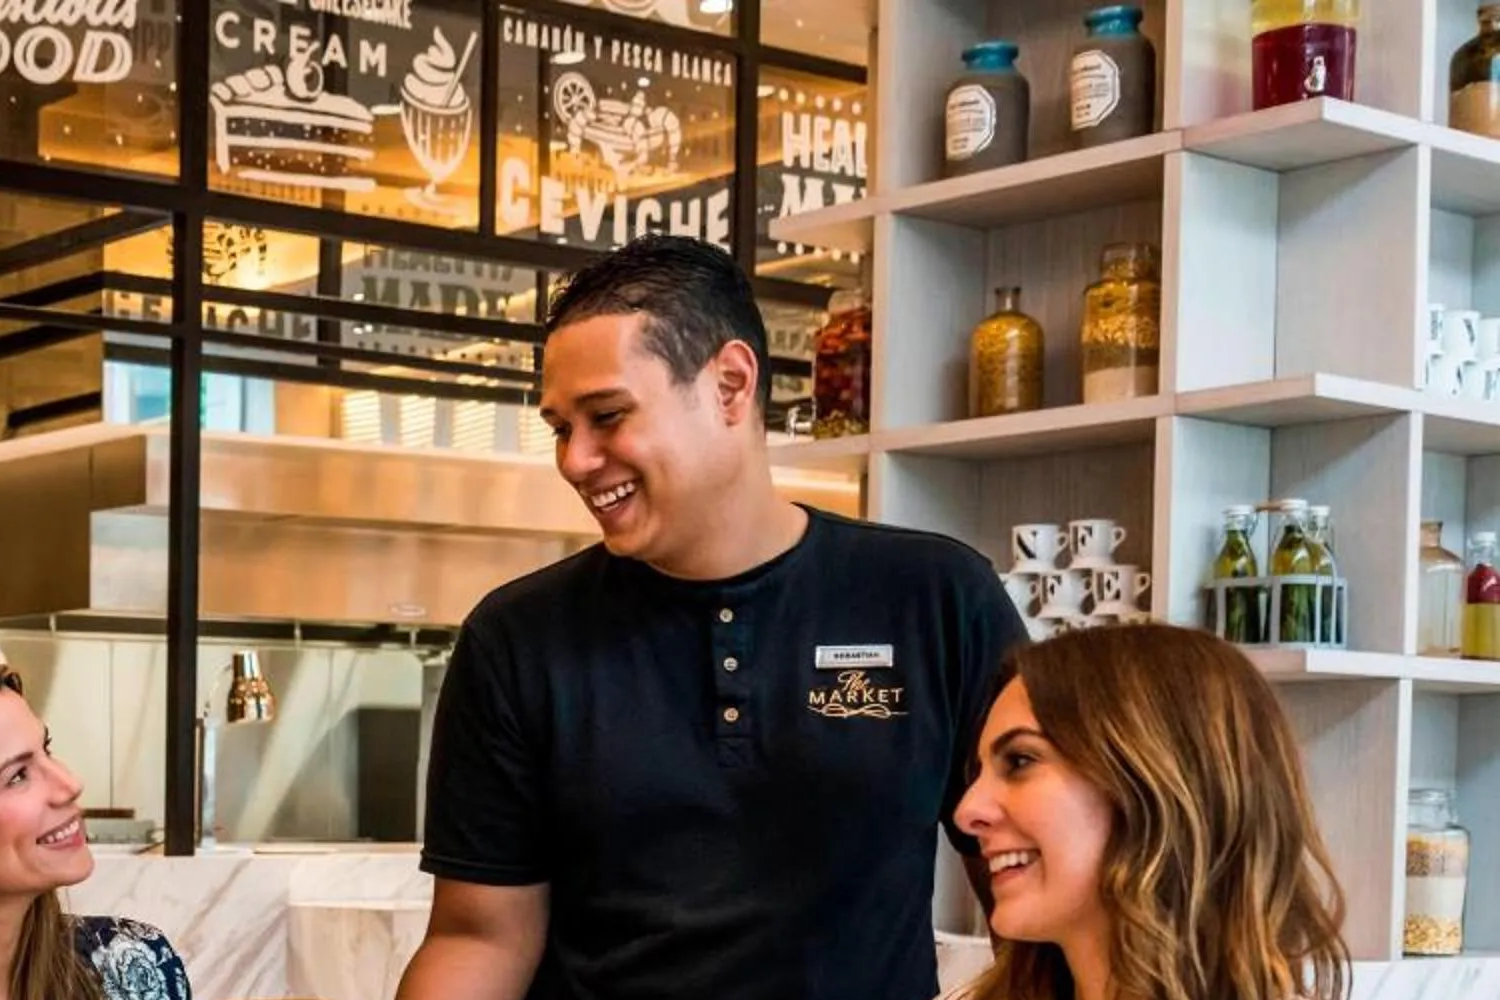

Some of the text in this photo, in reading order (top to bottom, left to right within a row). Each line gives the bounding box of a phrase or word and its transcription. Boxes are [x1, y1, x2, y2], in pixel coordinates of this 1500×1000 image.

[215, 11, 388, 78] CREAM
[594, 36, 603, 60] Y
[671, 51, 733, 87] BLANCA
[501, 157, 732, 254] CEVICHE
[808, 687, 904, 705] MARKET
